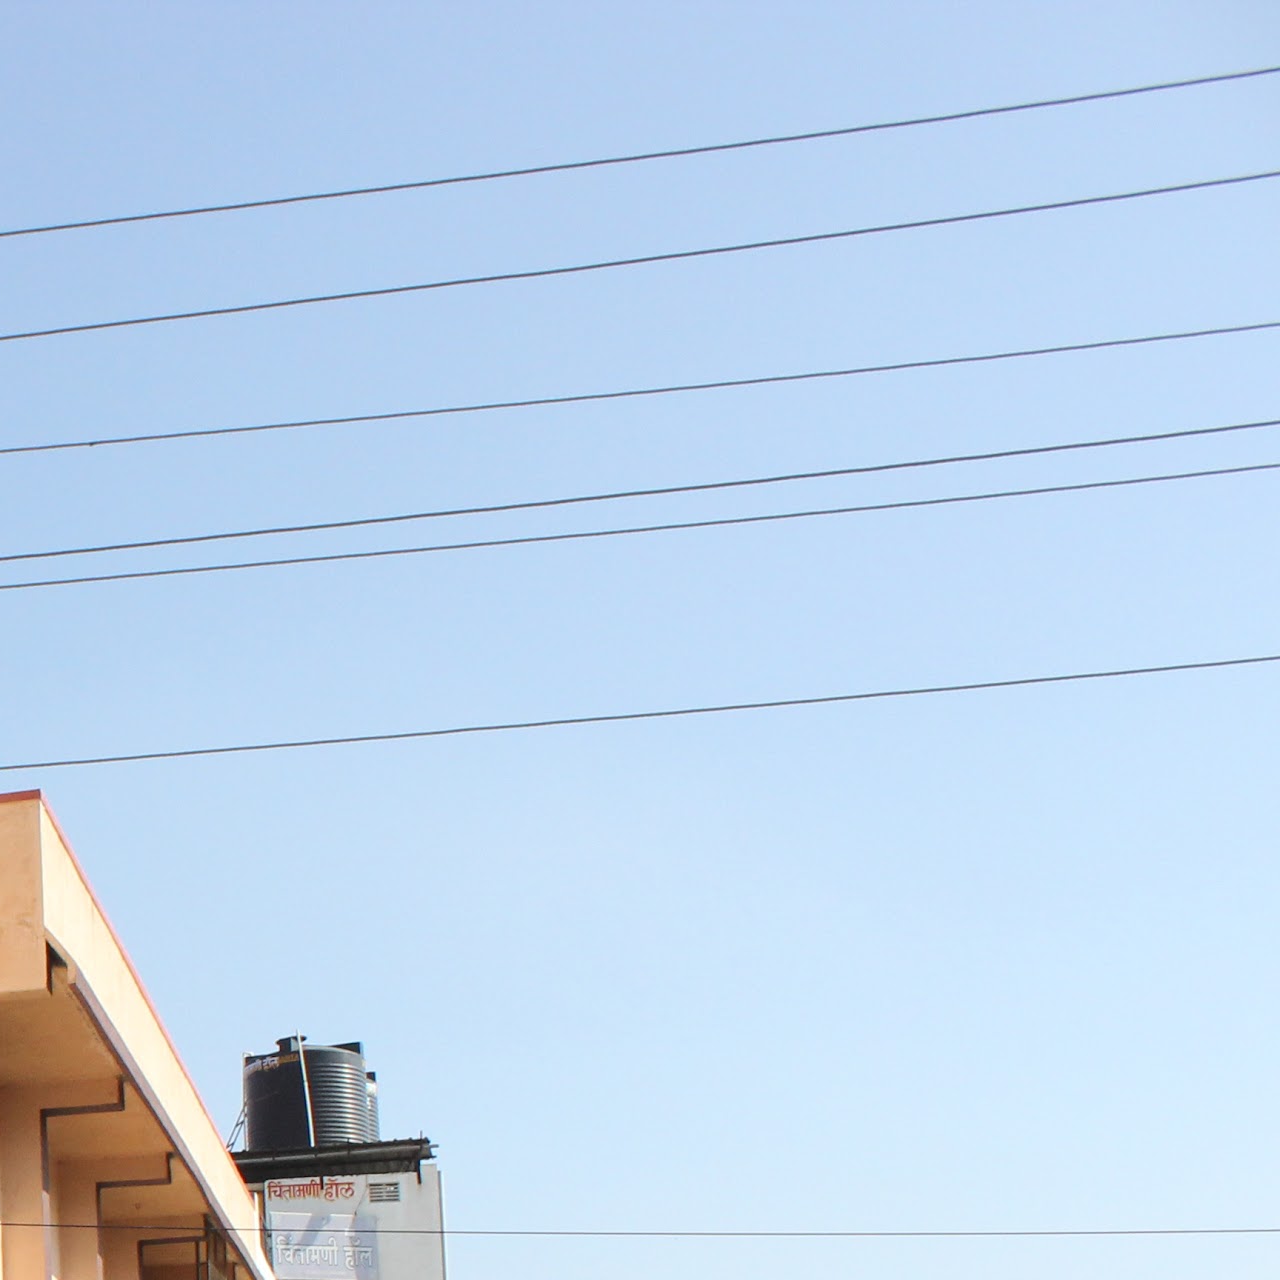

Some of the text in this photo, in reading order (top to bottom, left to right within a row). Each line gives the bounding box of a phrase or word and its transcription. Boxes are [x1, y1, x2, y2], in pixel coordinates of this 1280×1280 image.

[267, 1178, 355, 1201] चिंतामणी हॉल
[276, 1235, 339, 1265] चिंतामणी
